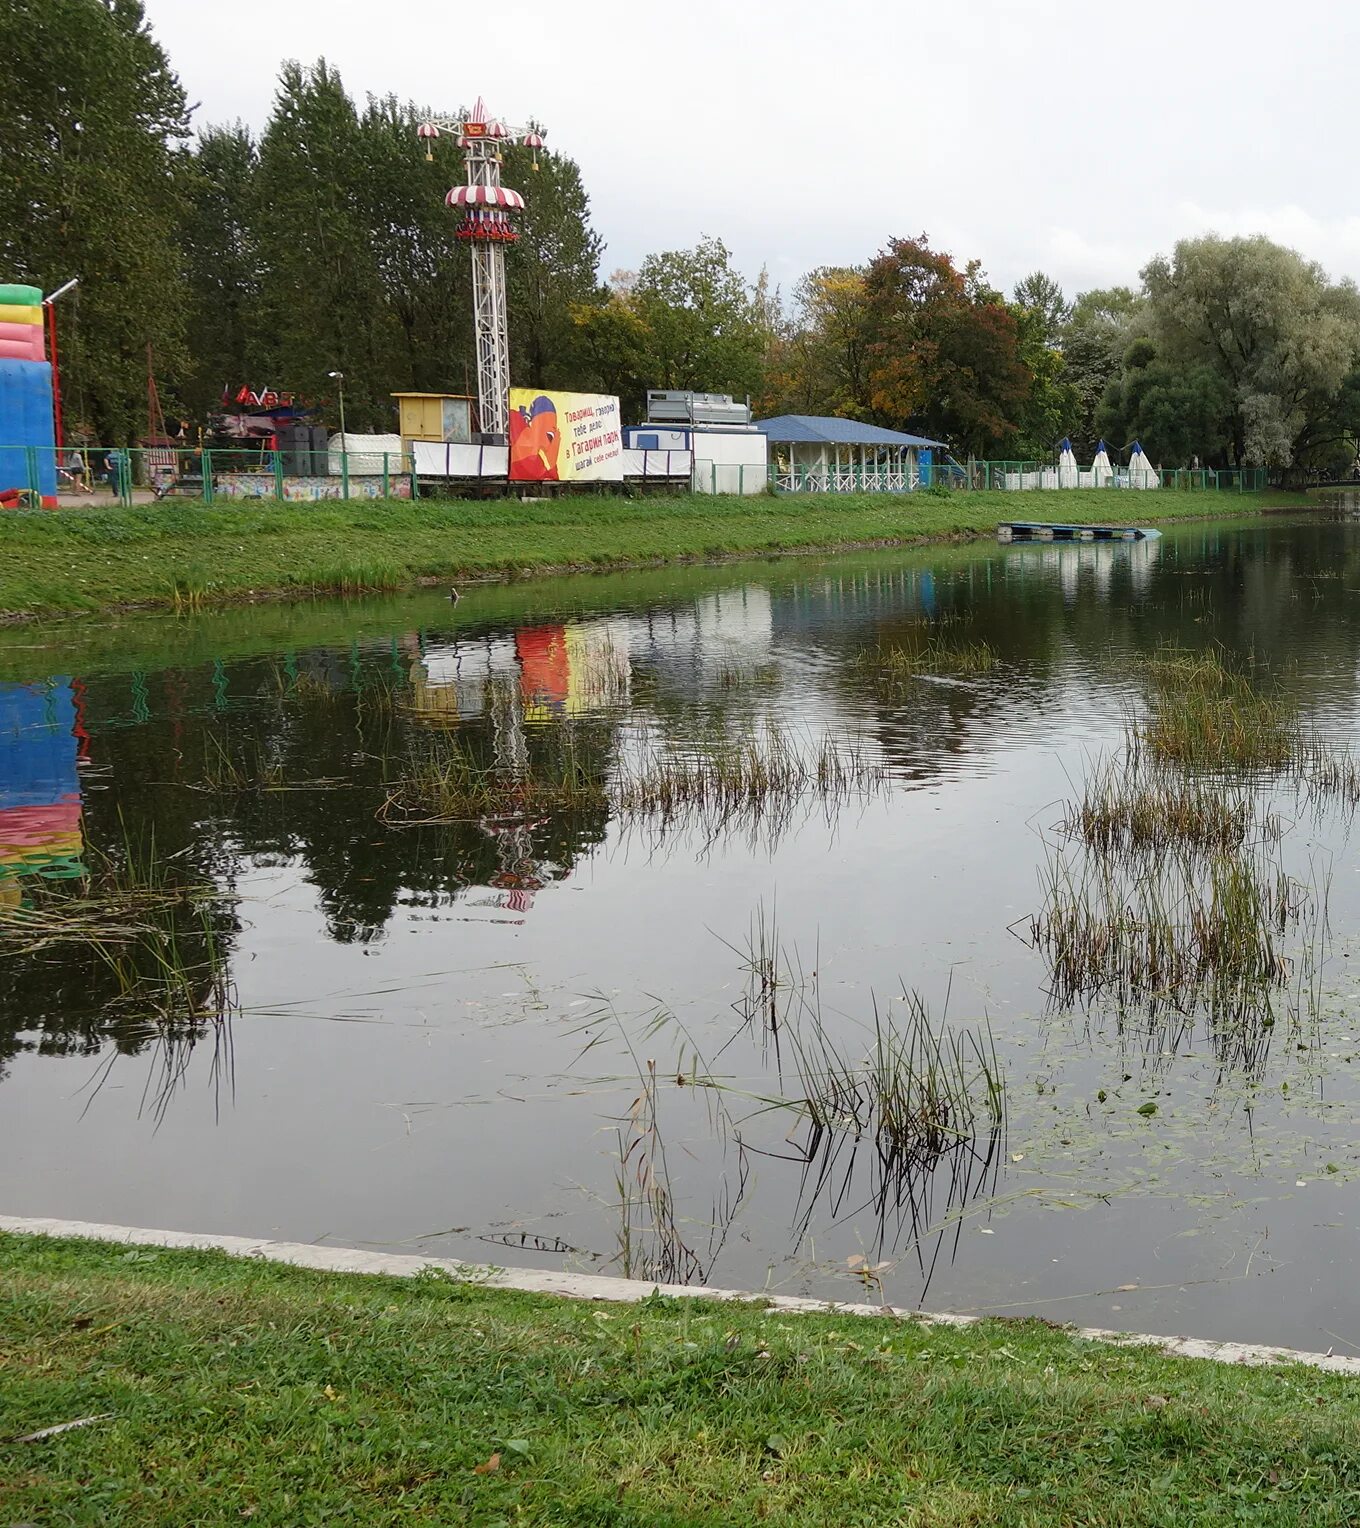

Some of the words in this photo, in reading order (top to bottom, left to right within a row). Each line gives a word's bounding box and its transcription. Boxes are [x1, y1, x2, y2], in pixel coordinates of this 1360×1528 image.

[573, 424, 587, 437] тебе
[566, 449, 571, 459] в
[572, 435, 603, 456] Гагарин
[603, 430, 619, 445] парк
[575, 456, 592, 471] шагай
[593, 453, 604, 463] себе
